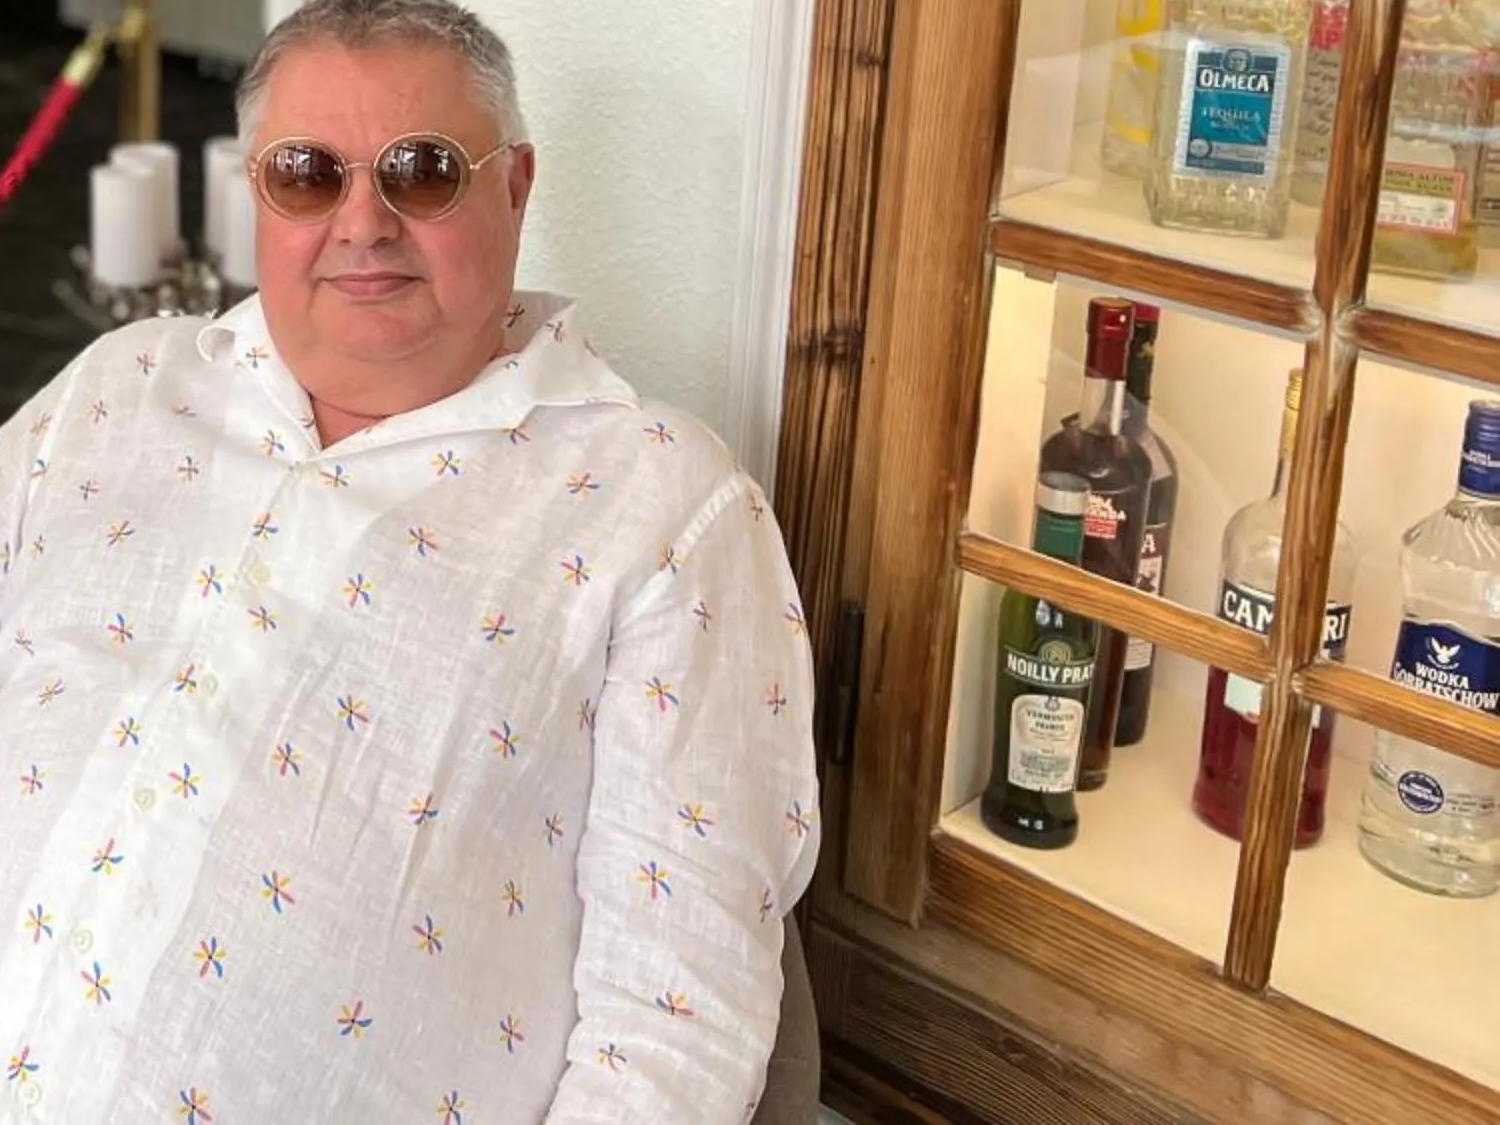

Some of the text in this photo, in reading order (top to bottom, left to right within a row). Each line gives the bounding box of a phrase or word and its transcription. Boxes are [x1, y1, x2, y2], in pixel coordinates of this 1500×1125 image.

[1200, 68, 1269, 92] OLMECA
[1223, 589, 1348, 643] CAMRI
[1007, 653, 1060, 684] NOILLY
[1415, 660, 1469, 690] WODKA
